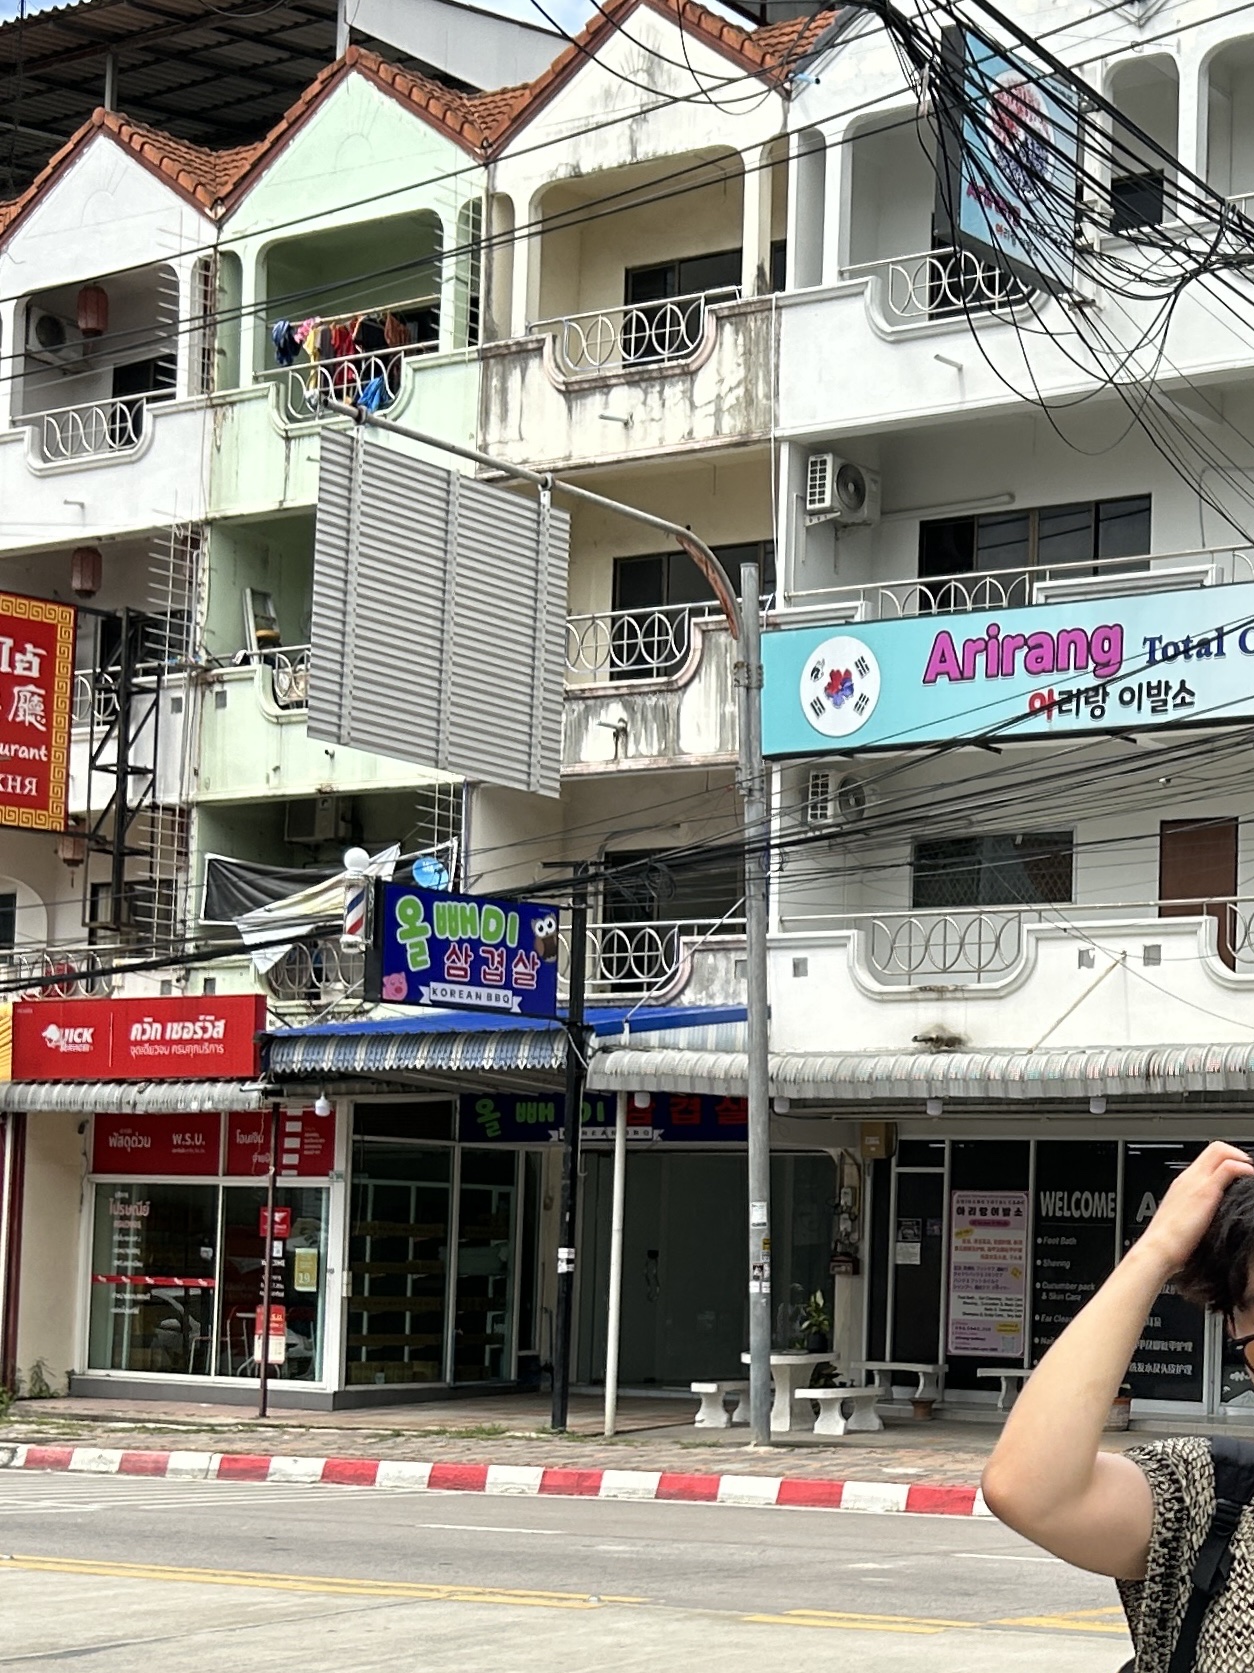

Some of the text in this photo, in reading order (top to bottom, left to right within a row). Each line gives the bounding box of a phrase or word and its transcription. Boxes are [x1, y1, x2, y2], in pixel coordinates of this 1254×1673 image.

[922, 622, 1124, 686] Arirang
[1143, 626, 1227, 666] Total
[1028, 679, 1196, 721] 아리랑 이발소
[395, 894, 519, 972] 올빼미
[444, 942, 541, 990] 삼겹살
[432, 986, 510, 1004] KOREAN BBQ
[1040, 1190, 1116, 1219] WELCOME
